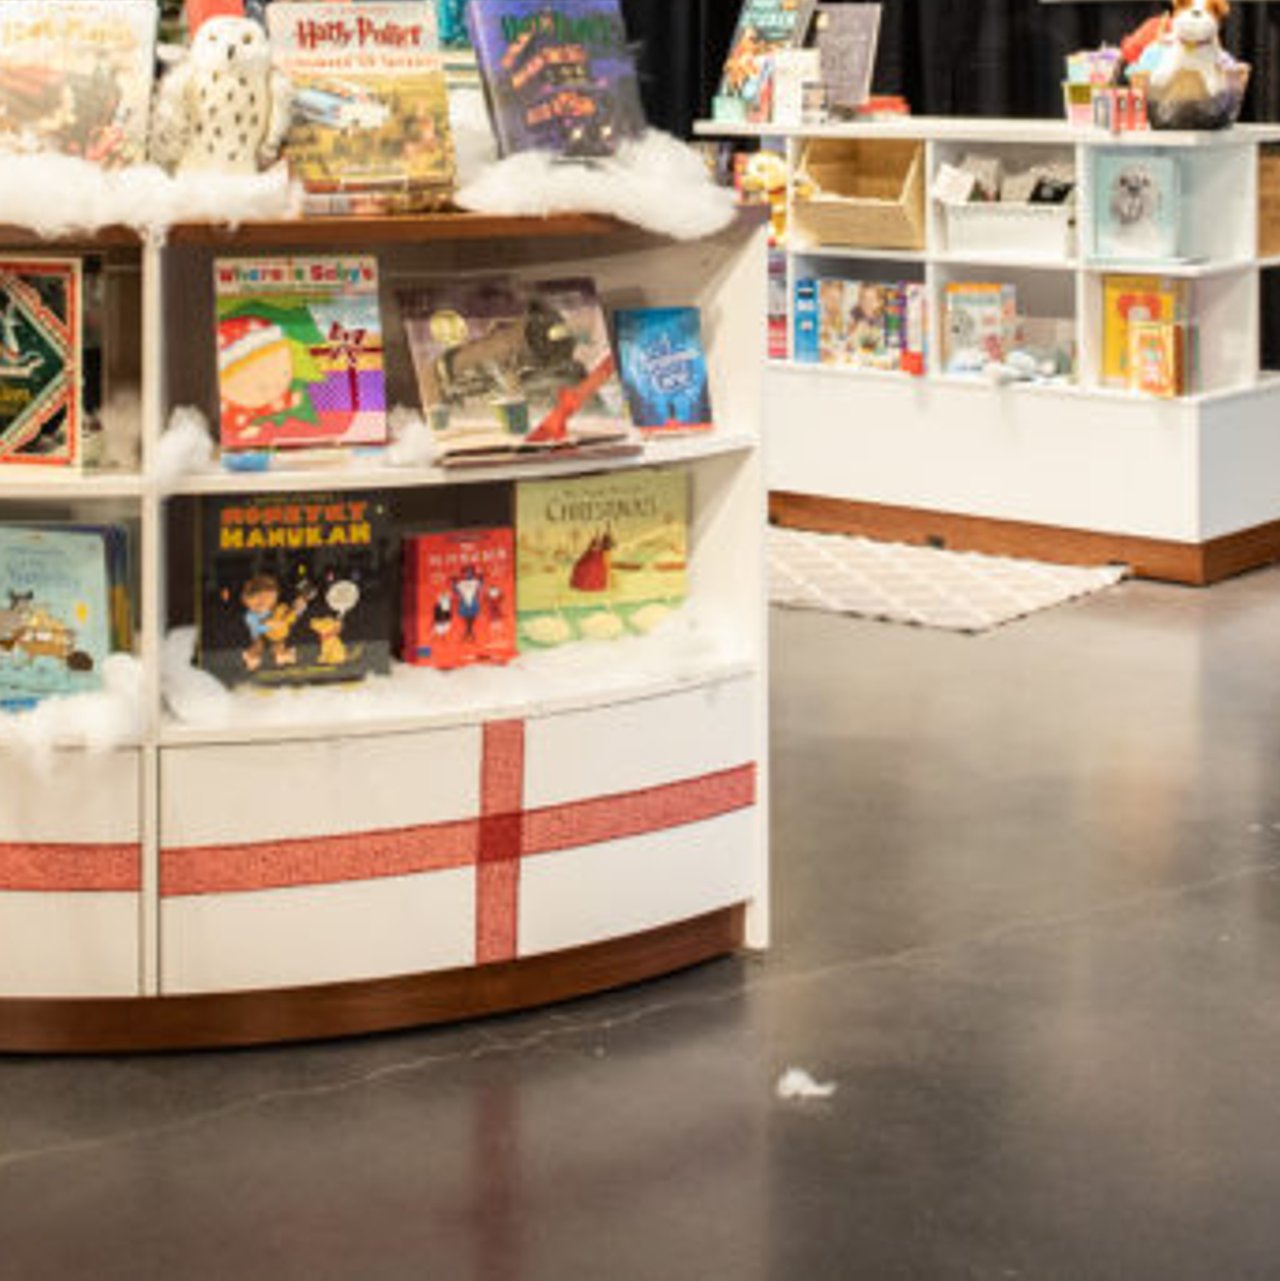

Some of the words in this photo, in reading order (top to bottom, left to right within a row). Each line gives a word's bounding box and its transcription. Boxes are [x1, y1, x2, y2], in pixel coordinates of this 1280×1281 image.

[297, 19, 353, 50] Harry
[356, 16, 421, 48] Potter
[220, 521, 371, 549] HANUKAH
